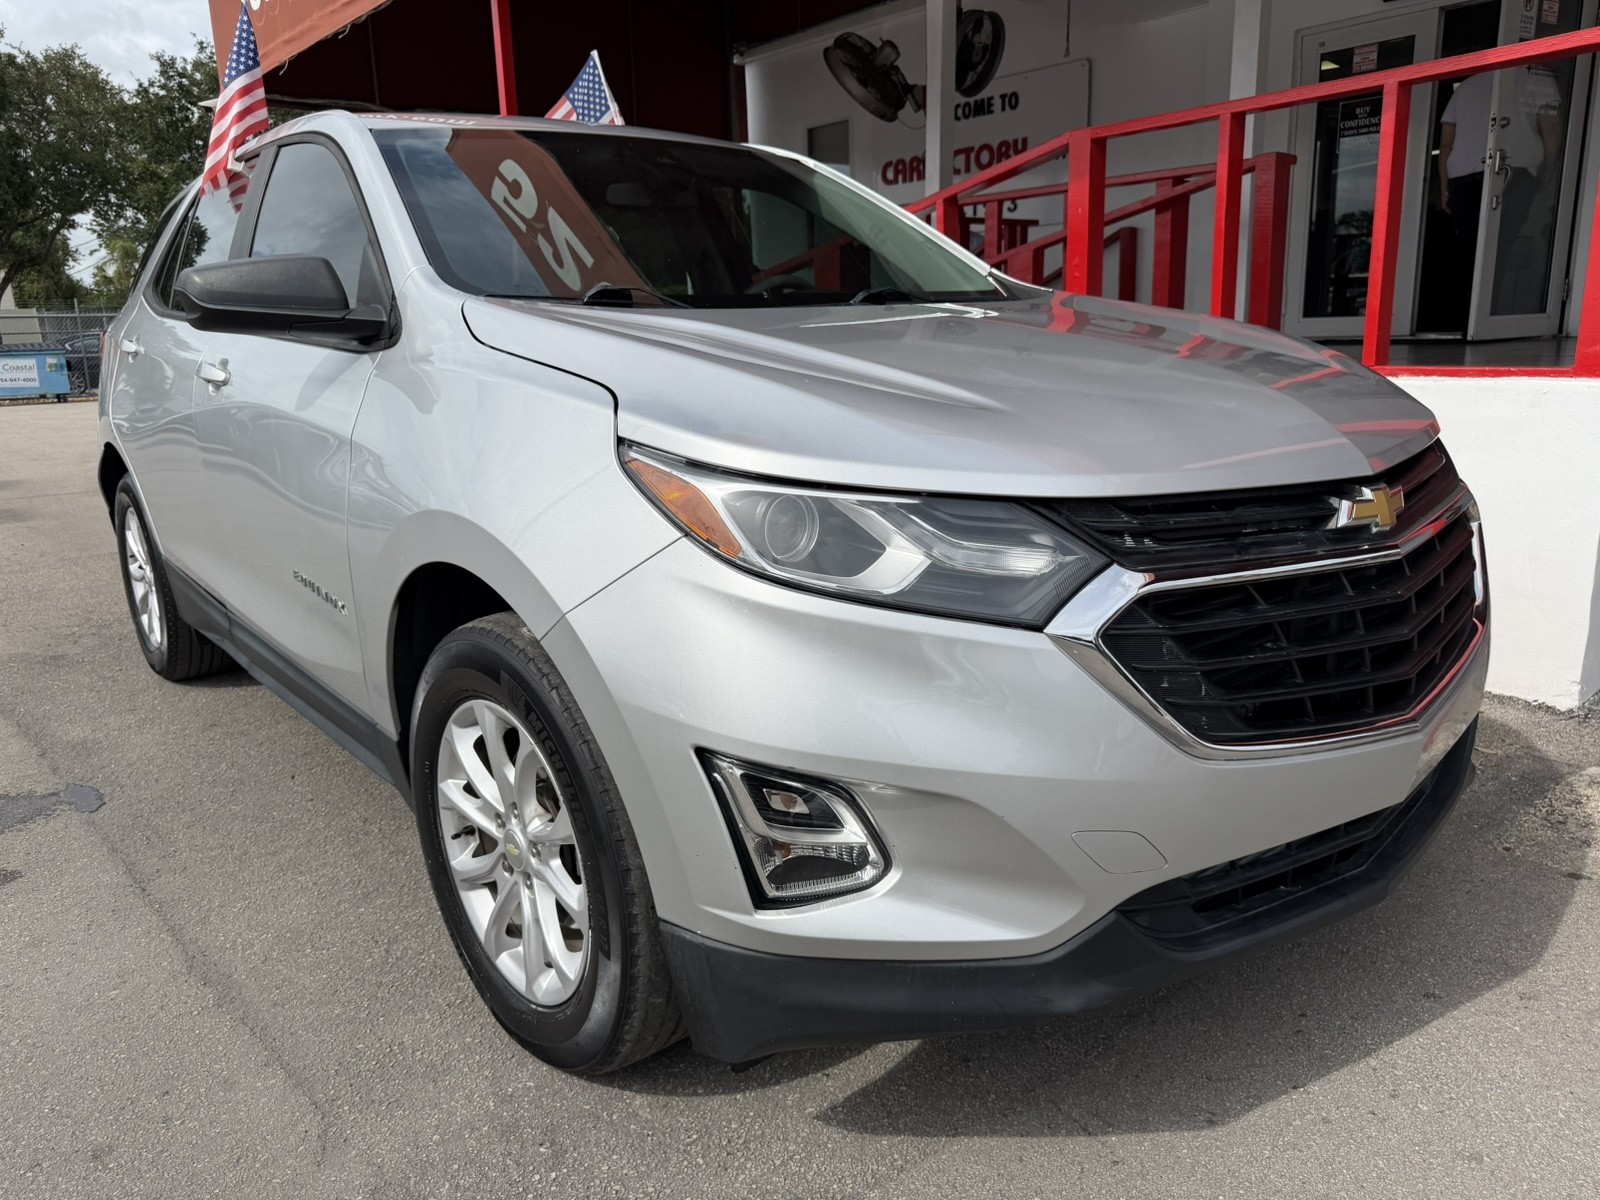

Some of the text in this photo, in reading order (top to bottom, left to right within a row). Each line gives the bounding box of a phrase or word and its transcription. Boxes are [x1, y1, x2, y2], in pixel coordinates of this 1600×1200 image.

[953, 91, 1020, 121] COME TO
[1355, 106, 1371, 115] BUY
[1340, 115, 1380, 129] CONFIDENC
[2, 363, 35, 371] Coastal
[293, 569, 348, 616] EQUINOX
[526, 710, 592, 838] MICHELIN
